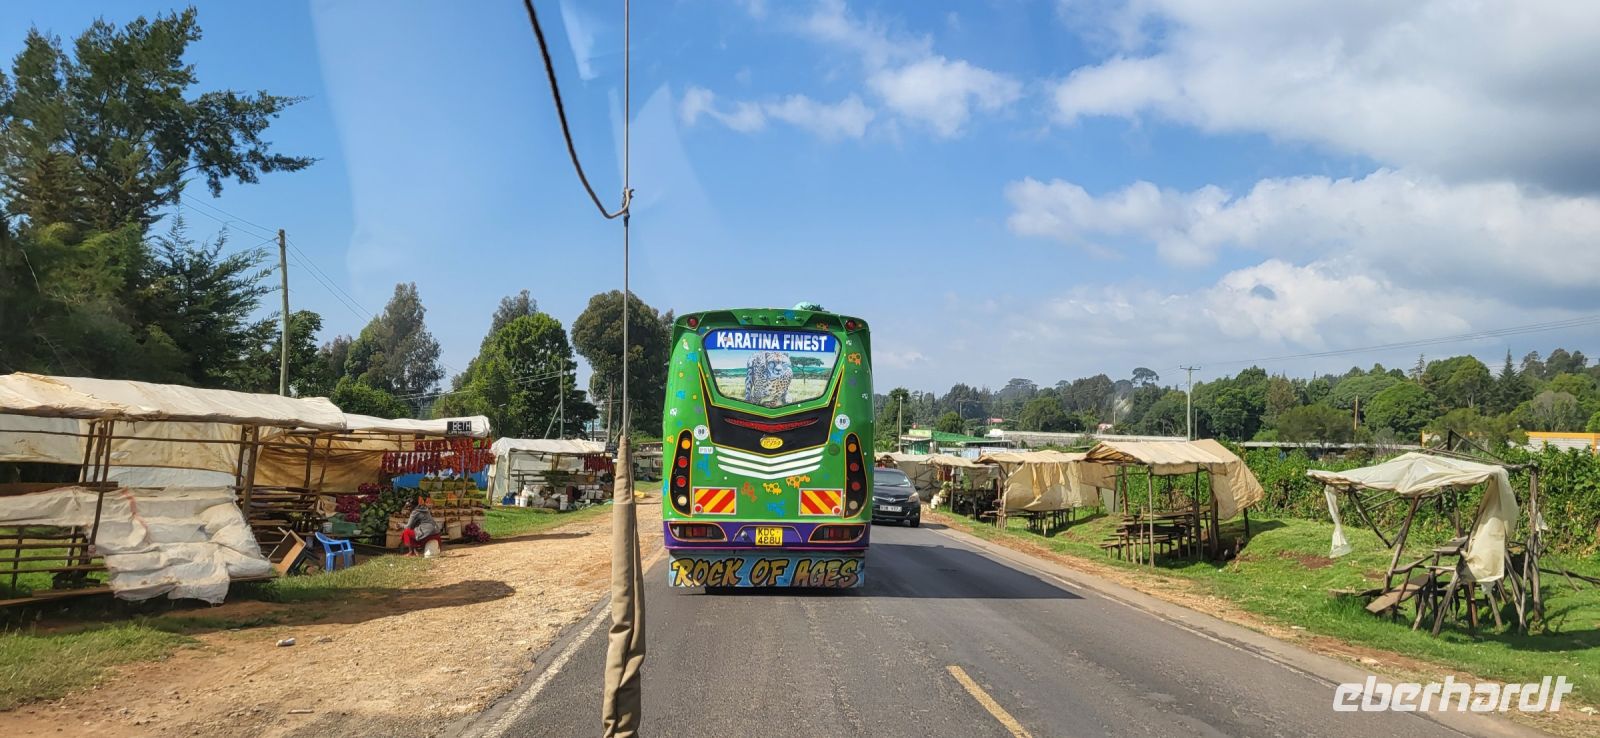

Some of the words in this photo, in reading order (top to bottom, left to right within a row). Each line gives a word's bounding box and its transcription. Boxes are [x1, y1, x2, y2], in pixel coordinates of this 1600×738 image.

[716, 331, 780, 350] KARATINA
[783, 333, 828, 352] FINEST
[452, 421, 471, 431] BETH
[758, 528, 775, 537] KDC
[671, 558, 744, 587] ROCK
[749, 558, 789, 586] OF
[789, 558, 859, 587] AGES
